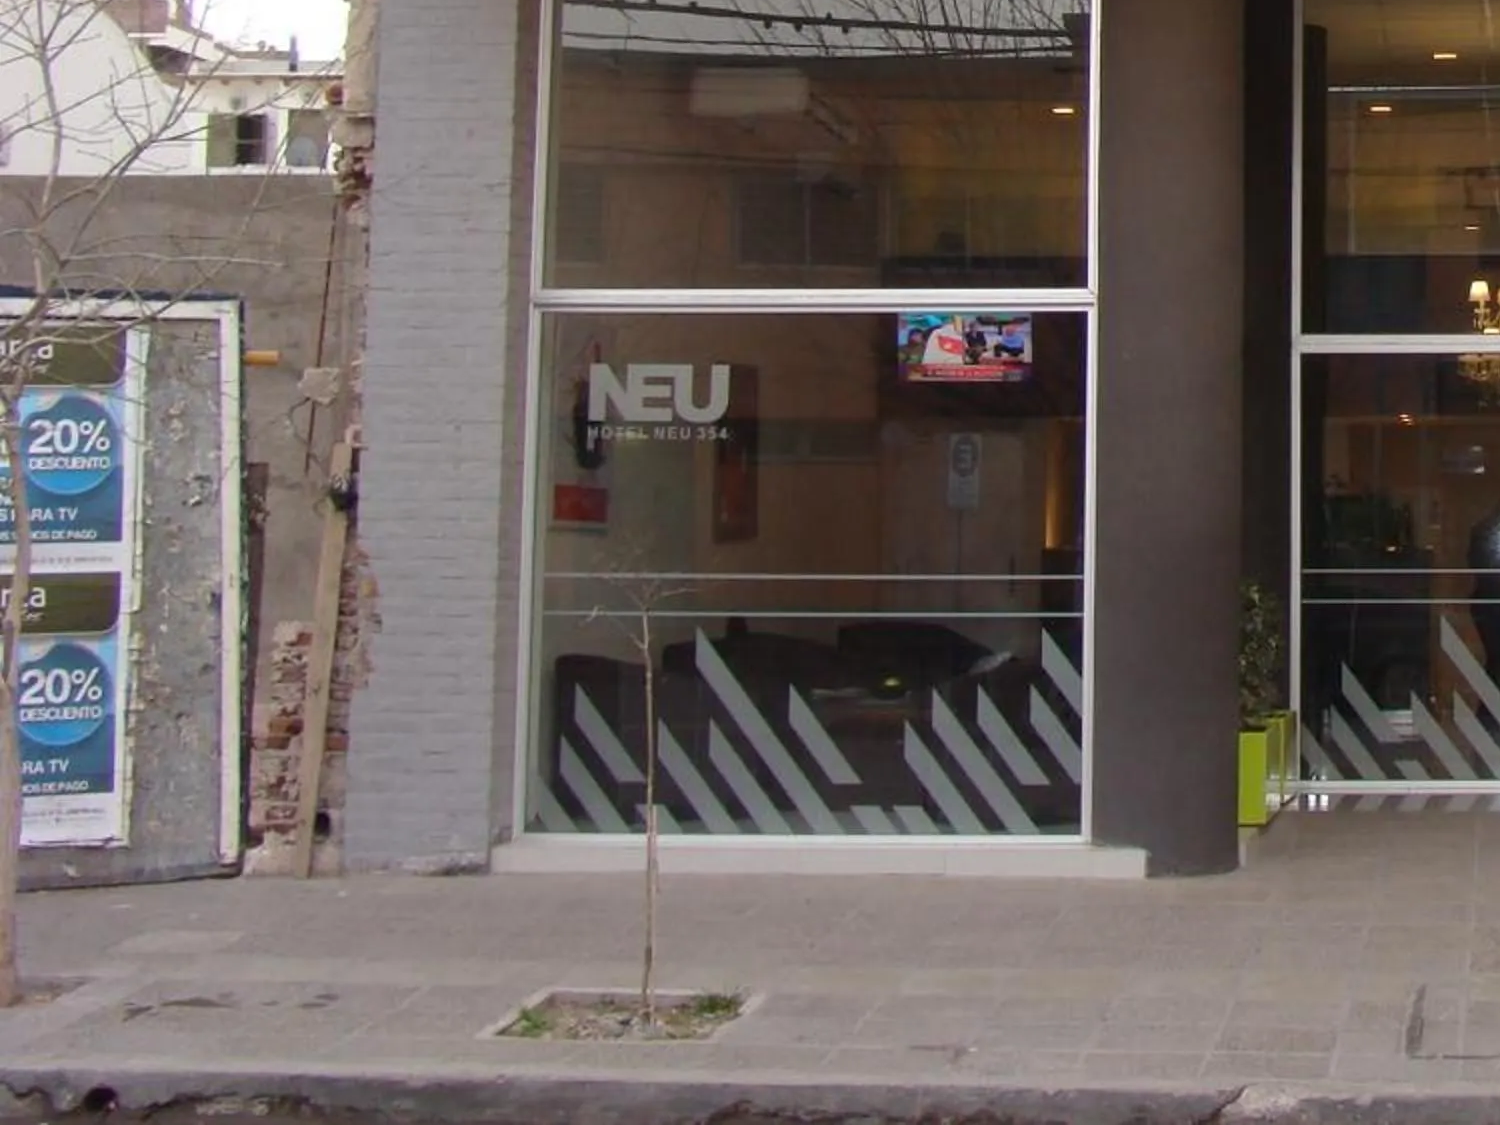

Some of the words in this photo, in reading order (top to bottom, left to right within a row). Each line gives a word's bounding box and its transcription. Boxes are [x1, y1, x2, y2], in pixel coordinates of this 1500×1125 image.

[588, 364, 731, 423] NEU
[28, 418, 111, 454] 20%
[588, 427, 649, 440] HOTEL
[653, 426, 691, 440] NEU
[696, 426, 729, 440] 354
[28, 456, 111, 470] DESCUENTO
[58, 507, 78, 521] TV
[20, 667, 103, 705] 20%
[20, 706, 102, 722] DESCUENTO
[48, 758, 70, 774] TV
